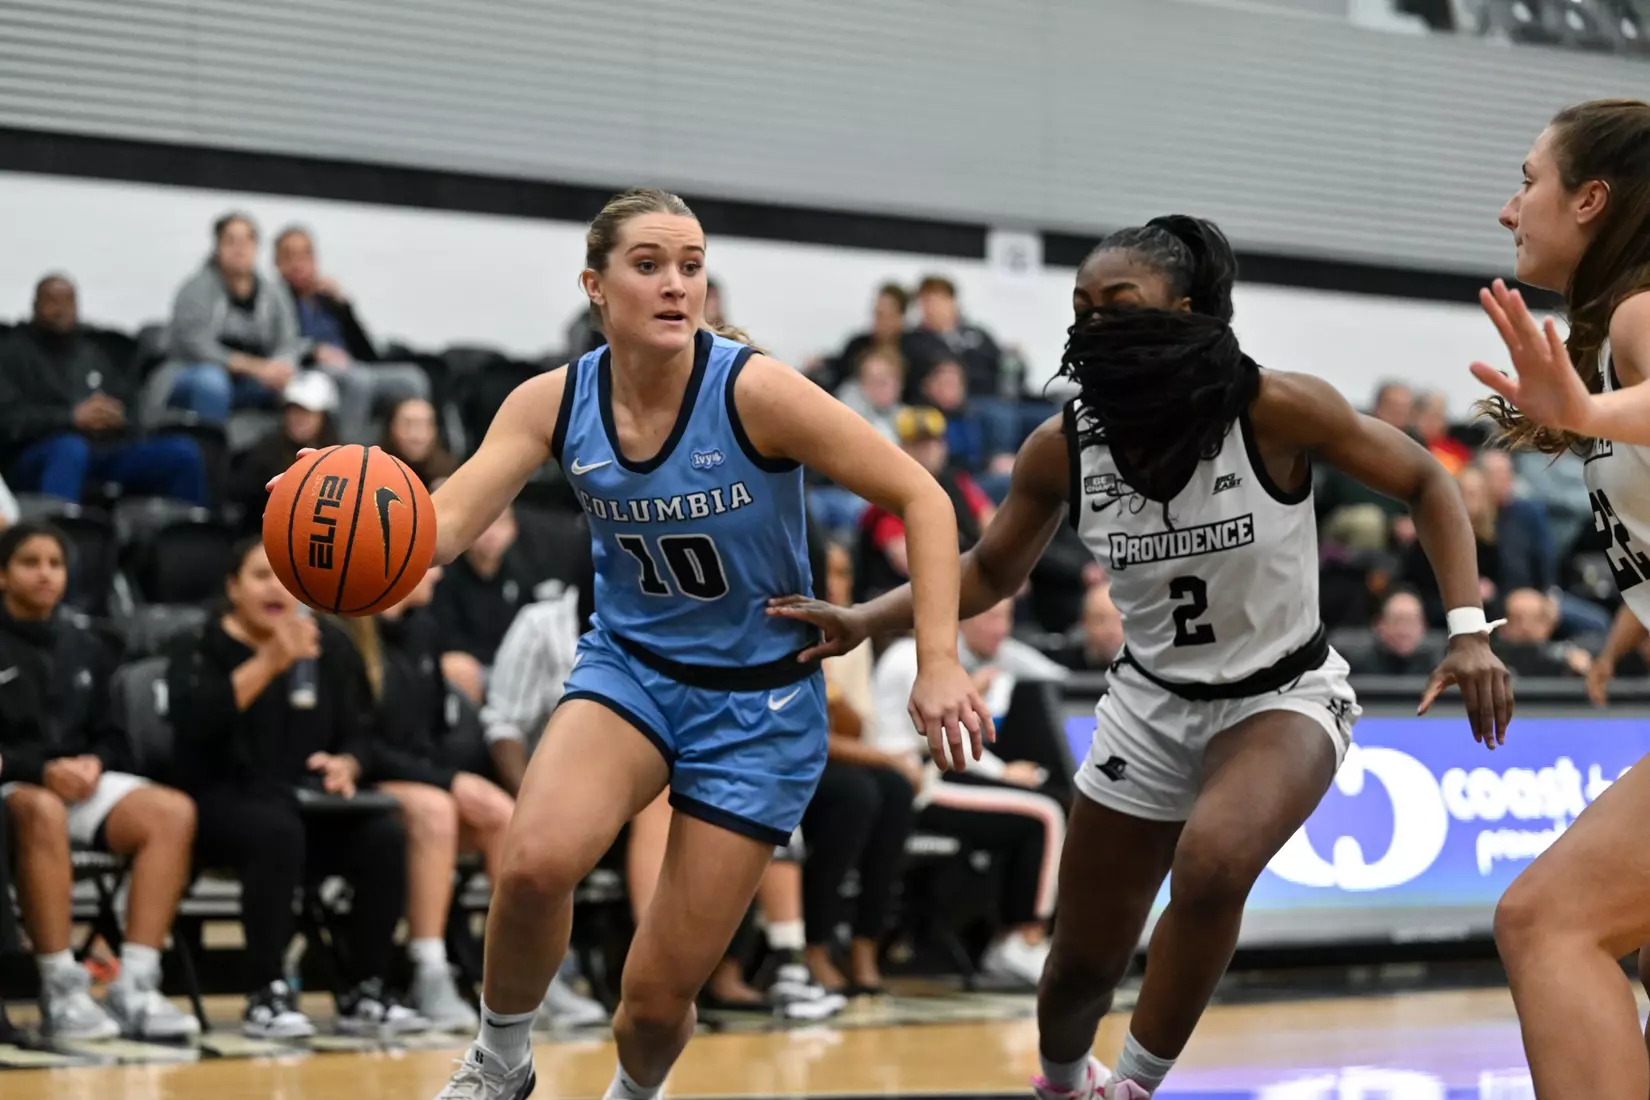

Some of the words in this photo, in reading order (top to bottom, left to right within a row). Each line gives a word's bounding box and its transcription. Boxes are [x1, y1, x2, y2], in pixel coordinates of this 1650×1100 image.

[309, 476, 348, 570] ELITE
[580, 481, 752, 522] COLUMBIA
[615, 533, 730, 602] 10
[1109, 514, 1254, 570] PROVIDENCE
[1169, 575, 1216, 647] 2
